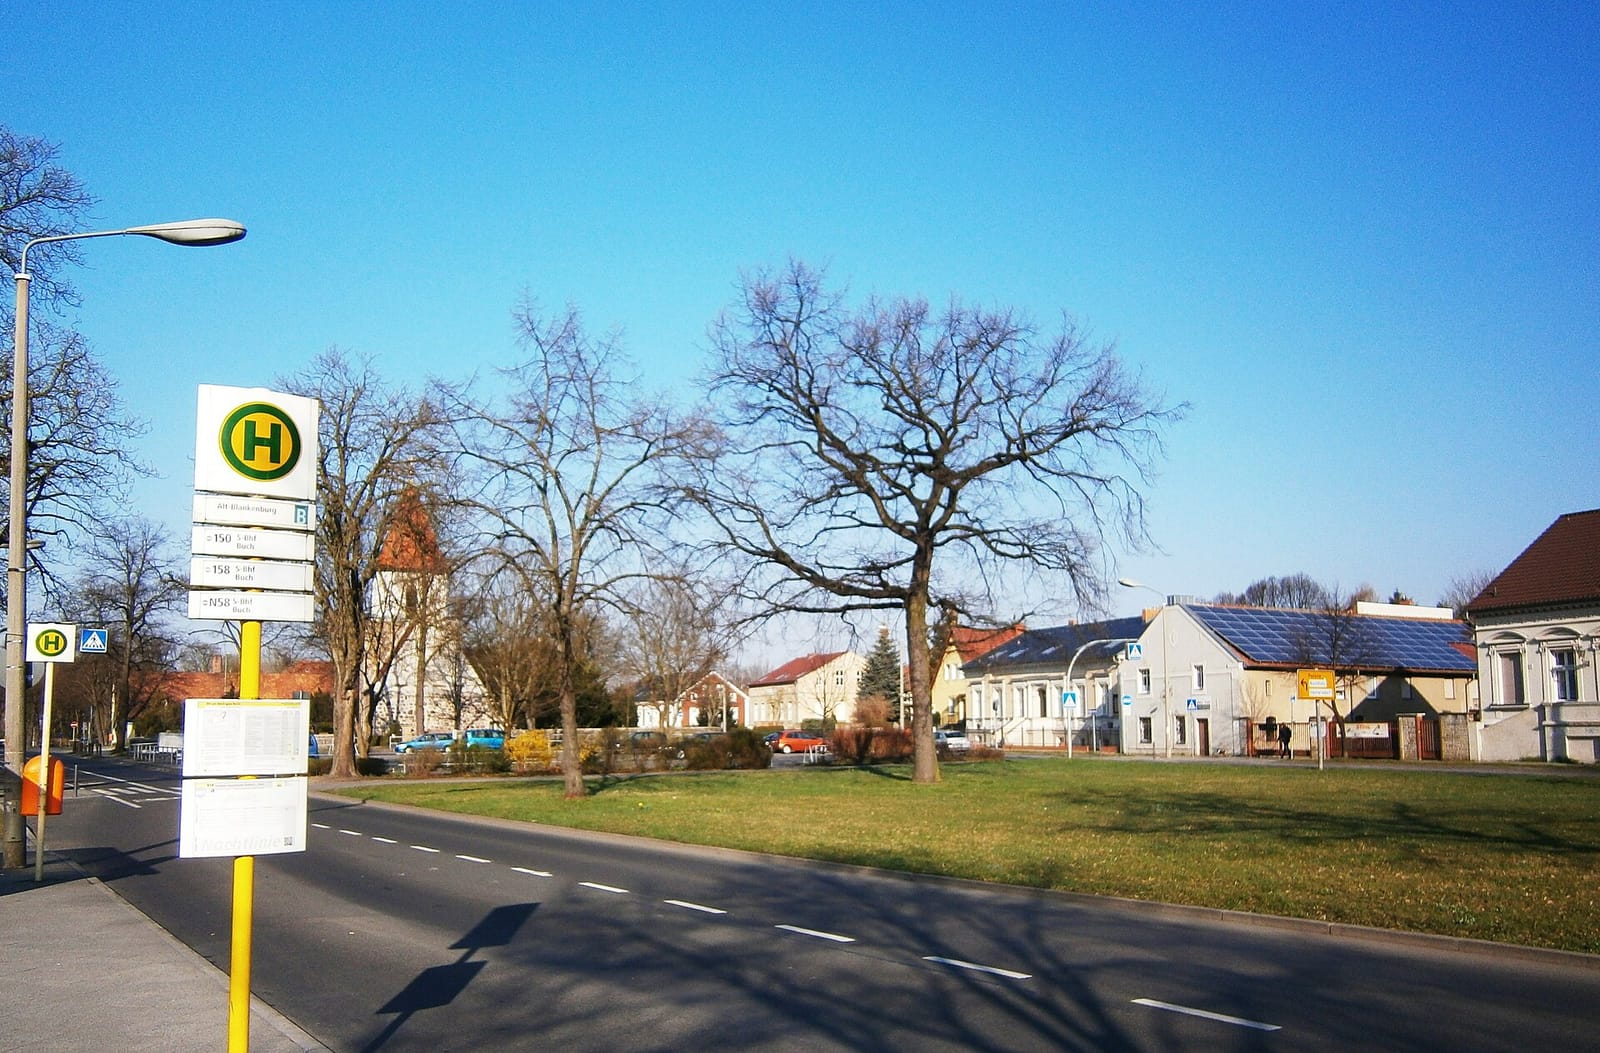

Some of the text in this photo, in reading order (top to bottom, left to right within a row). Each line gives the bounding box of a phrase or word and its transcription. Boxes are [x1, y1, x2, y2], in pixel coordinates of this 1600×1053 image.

[243, 420, 282, 464] H
[217, 503, 277, 515] Alt-Blankenburg
[214, 533, 232, 543] 150
[236, 542, 255, 550] Buch
[212, 565, 231, 574] 158
[235, 573, 254, 581] Buch
[209, 597, 231, 607] N58
[232, 606, 251, 614] Buch
[44, 635, 60, 651] H
